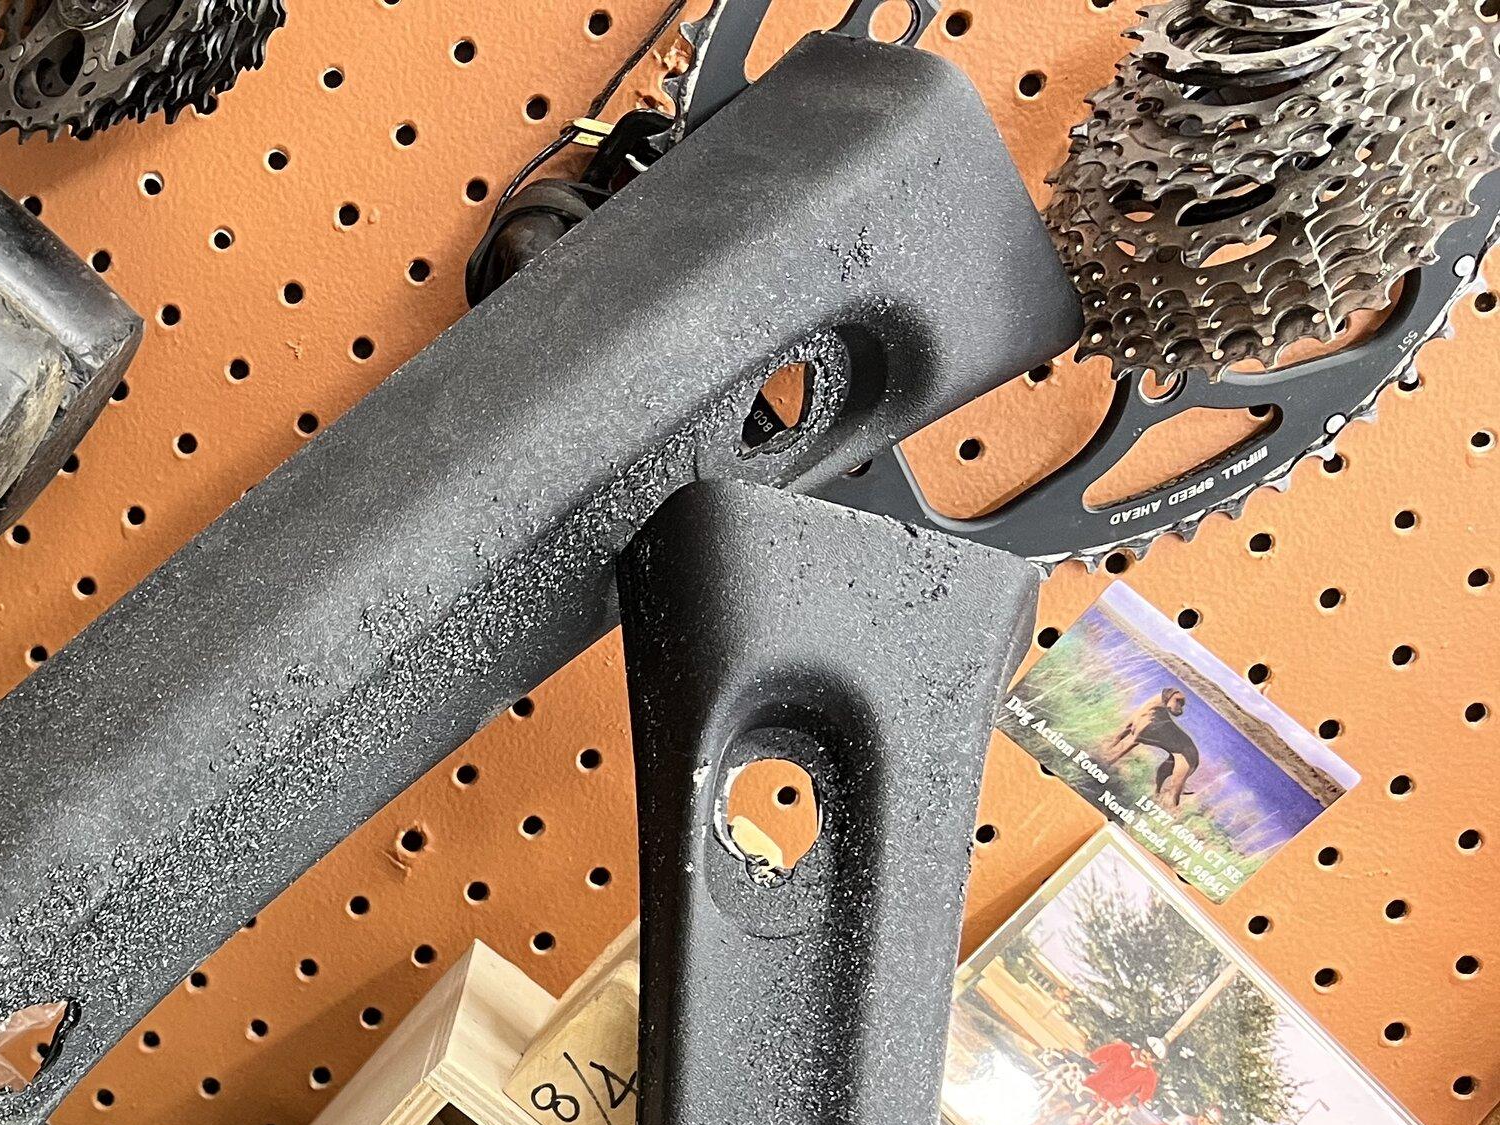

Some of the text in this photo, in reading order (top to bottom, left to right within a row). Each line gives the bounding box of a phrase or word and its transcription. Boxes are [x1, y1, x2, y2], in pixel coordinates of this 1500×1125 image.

[1399, 328, 1420, 354] 55T
[751, 408, 775, 433] BCD
[1168, 477, 1216, 508] SPEED
[1108, 498, 1163, 527] AHEAD
[1004, 695, 1111, 786] Dog Action Fotos
[1096, 790, 1140, 827] North
[1132, 818, 1173, 859] Bend,
[1168, 842, 1199, 869] WA
[1134, 794, 1178, 832] 13727
[1200, 842, 1225, 870] CT
[1221, 857, 1245, 885] SE
